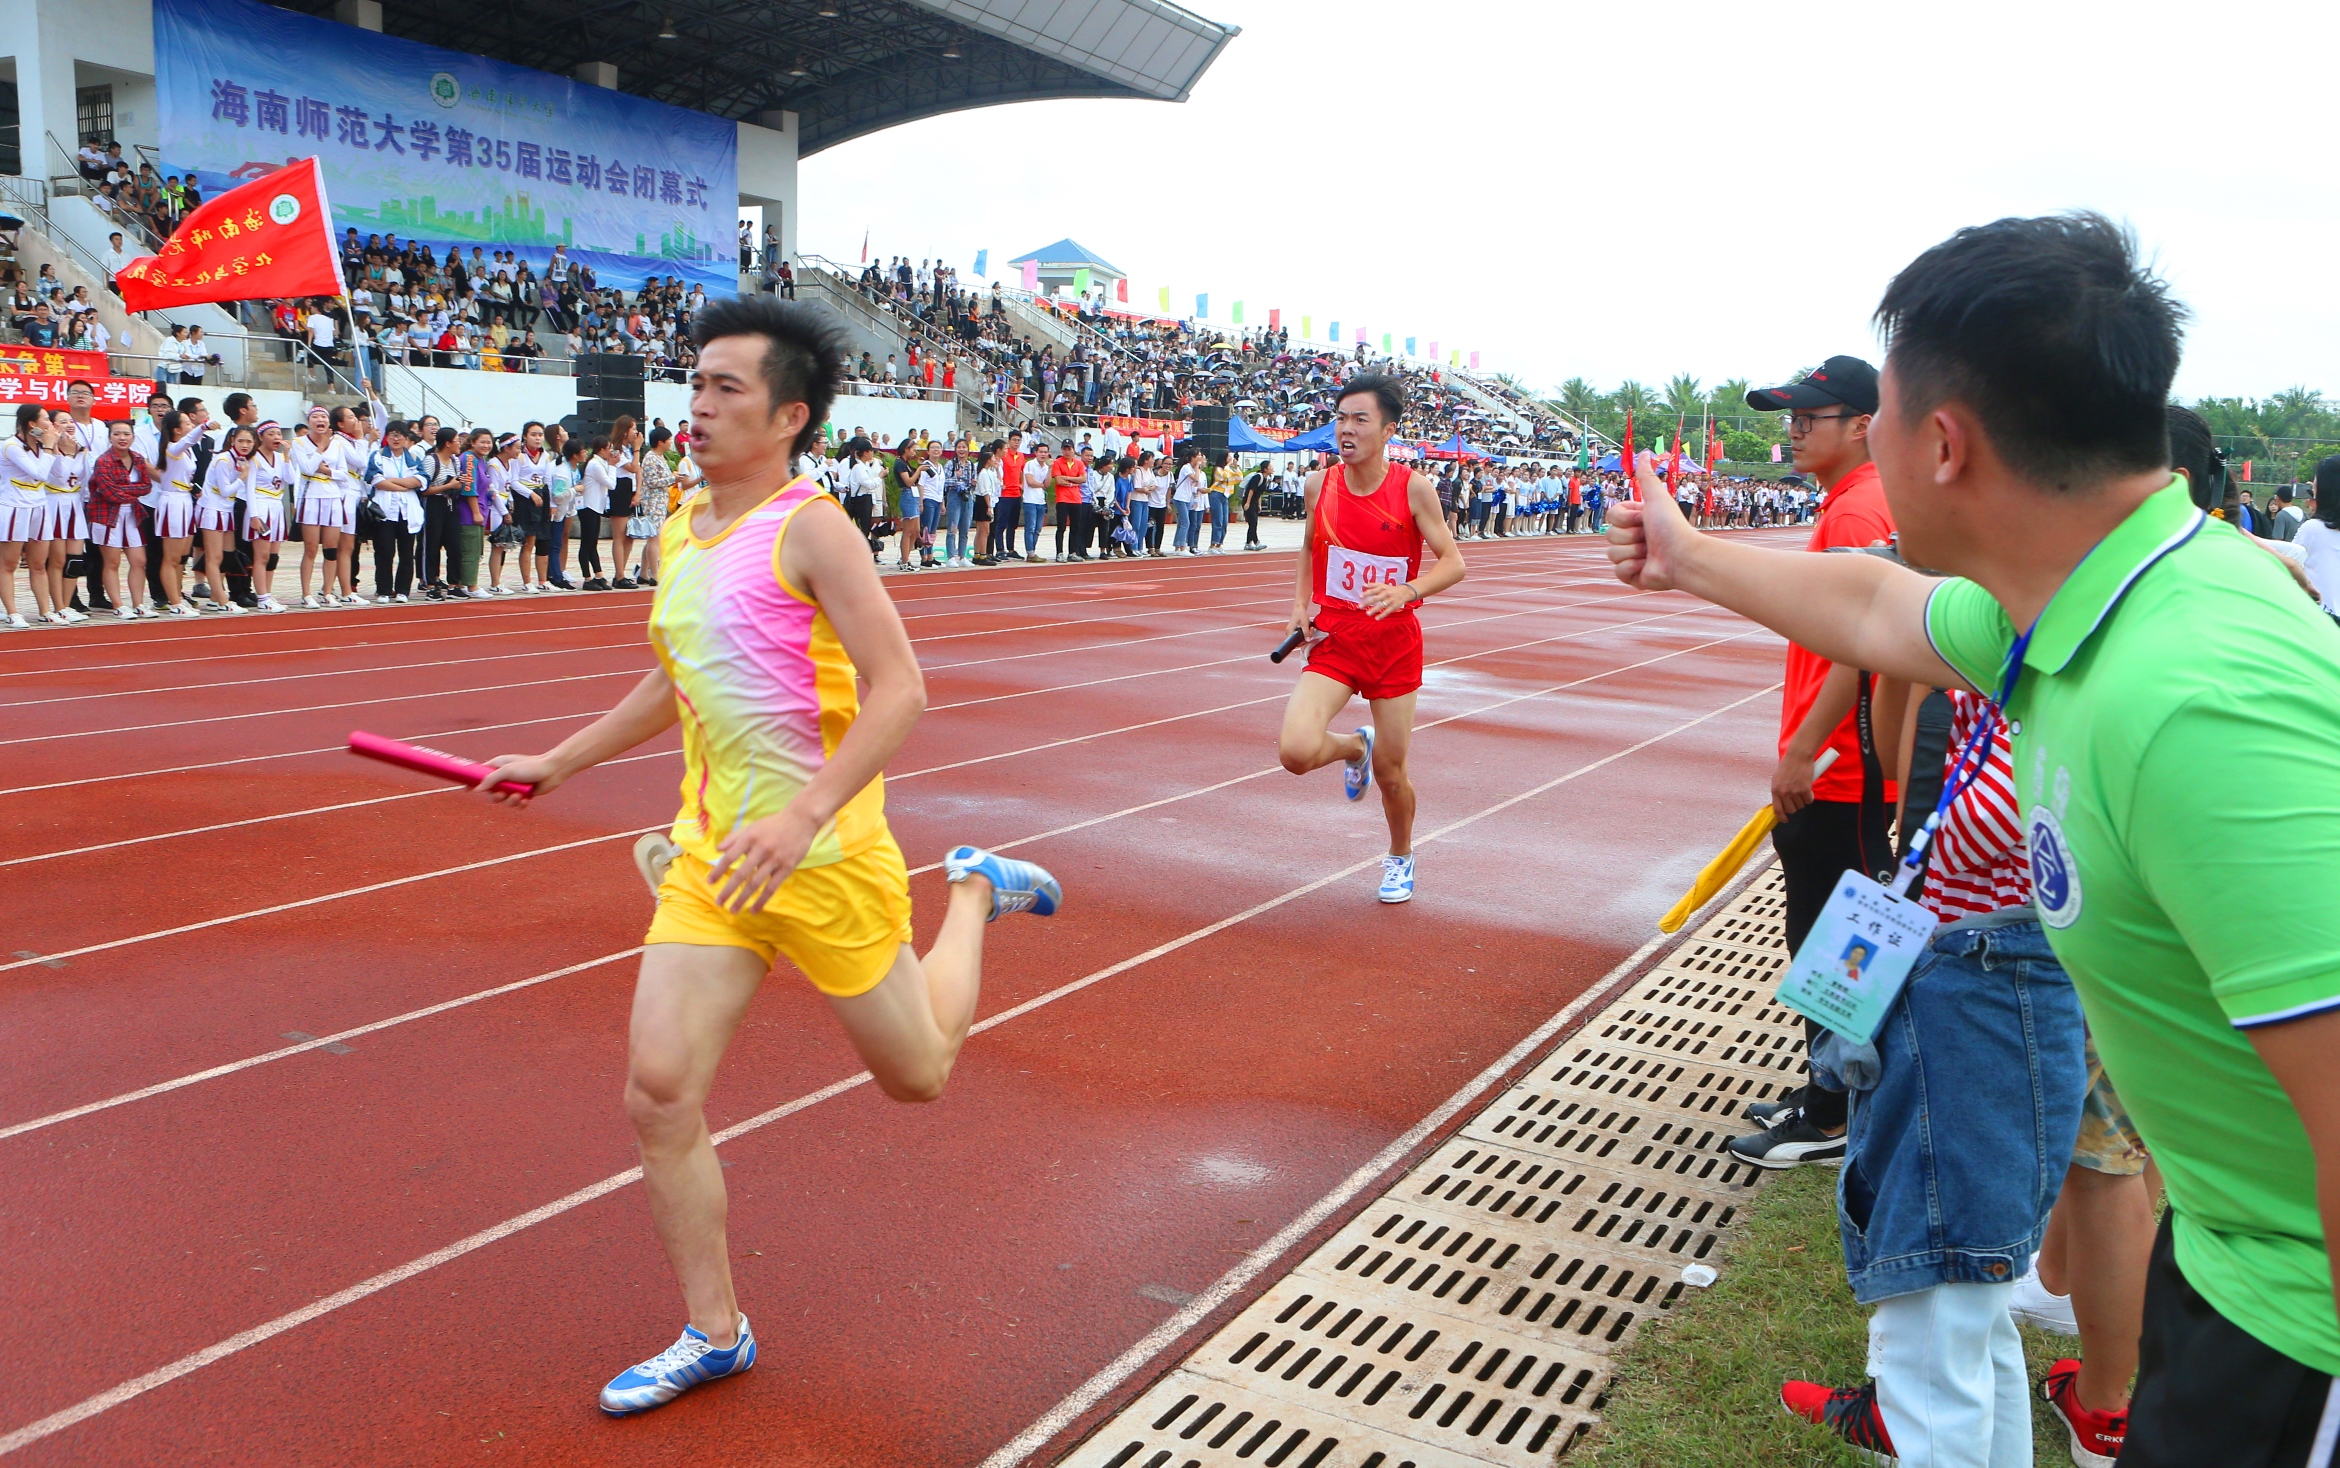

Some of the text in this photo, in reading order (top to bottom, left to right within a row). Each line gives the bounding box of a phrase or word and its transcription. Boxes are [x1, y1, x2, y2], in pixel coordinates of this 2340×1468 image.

[210, 78, 708, 212] 海南师范大学第35届运动会闭幕式
[1859, 695, 1870, 755] Canon
[1846, 912, 1903, 948] 工作证
